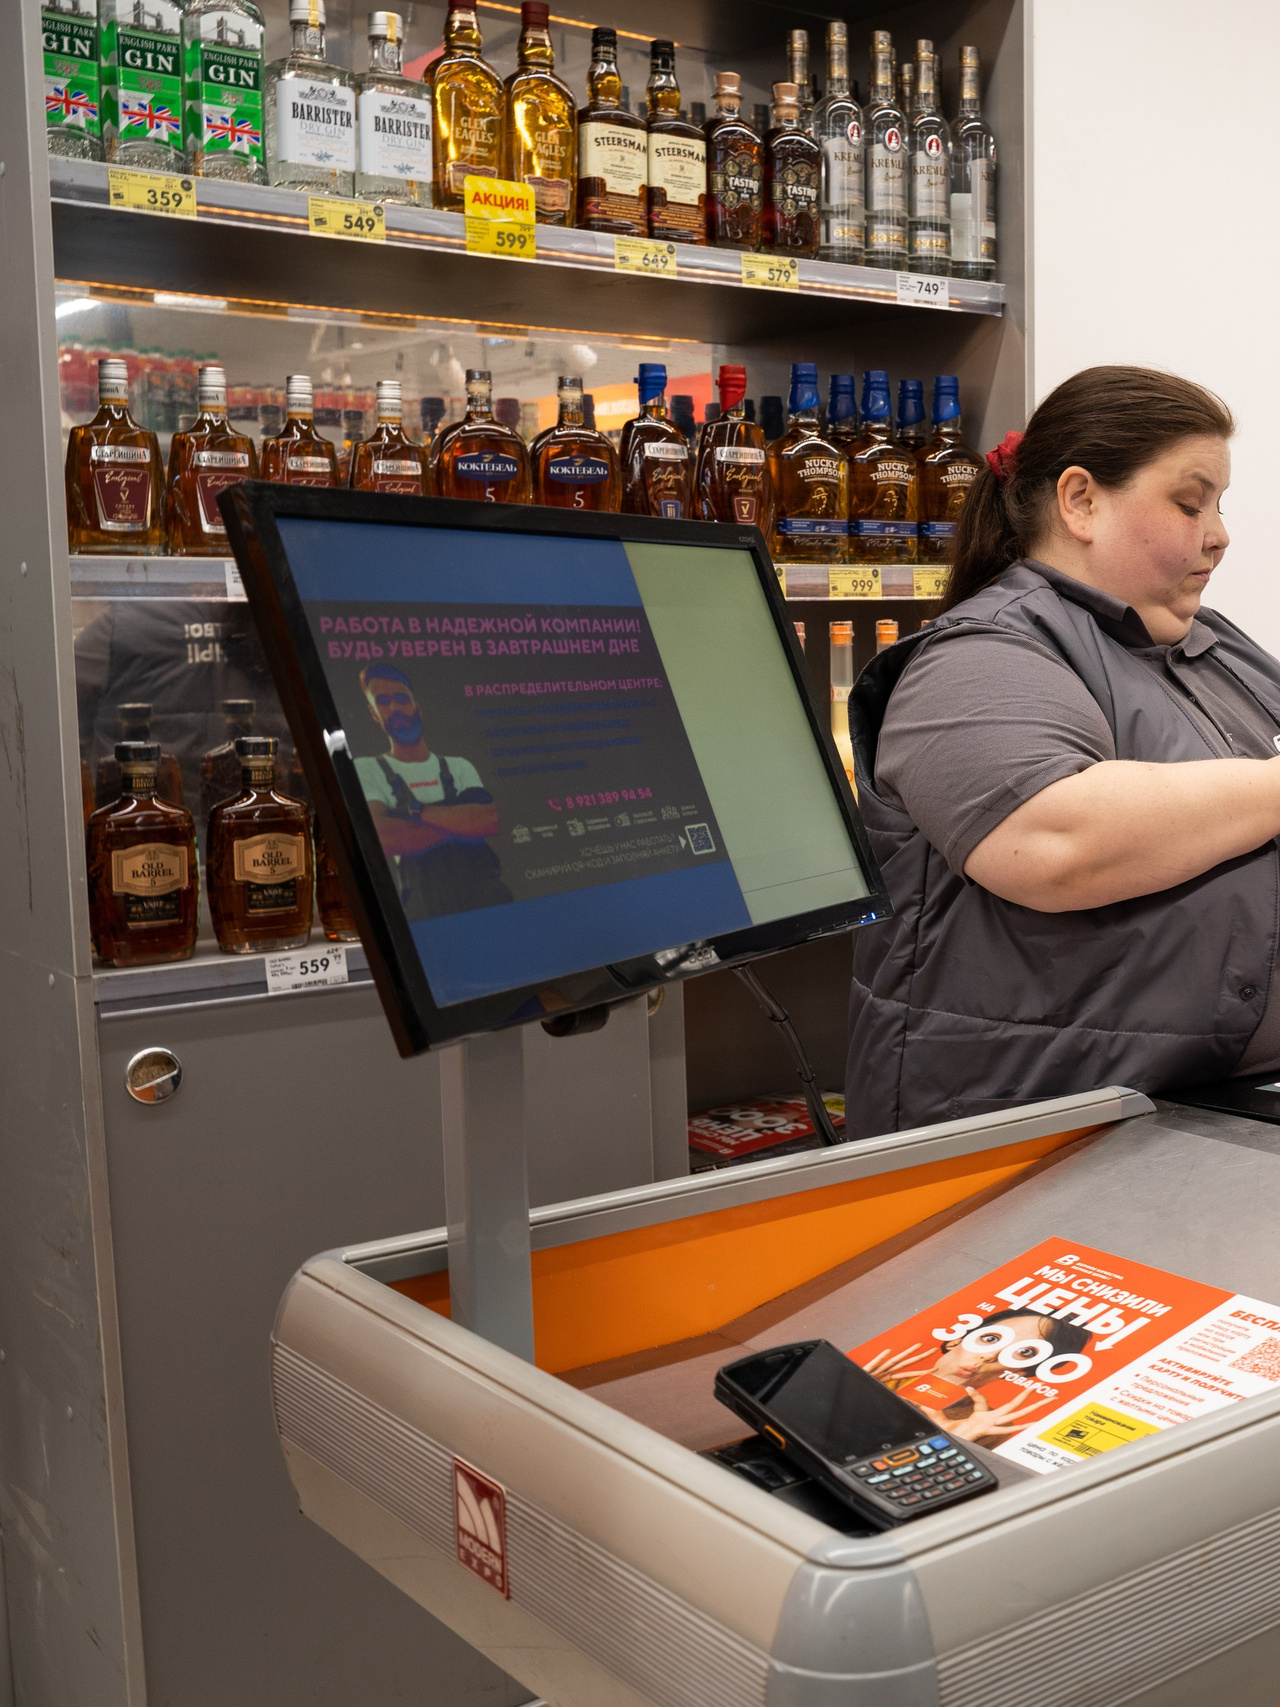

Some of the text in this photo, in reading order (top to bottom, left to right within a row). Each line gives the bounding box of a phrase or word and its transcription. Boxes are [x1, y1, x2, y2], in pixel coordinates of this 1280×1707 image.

[42, 32, 91, 58] GIN
[119, 35, 178, 54] ENGLISH PARK
[124, 50, 174, 73] GIN
[204, 50, 259, 69] ENGLISH PARK
[208, 64, 255, 87] GIN
[291, 101, 353, 128] BARRISTER
[460, 116, 487, 130] GLEN
[300, 120, 322, 133] DRY
[325, 125, 346, 136] GIN
[374, 115, 431, 141] BARRISTER
[455, 127, 494, 144] EAGLES
[382, 134, 402, 145] DRY
[405, 139, 426, 149] GIN
[534, 131, 560, 144] GLEN
[594, 135, 647, 155] STEERSMAN
[655, 147, 706, 165] STEERSMAN
[729, 177, 759, 193] CASTRO
[147, 188, 183, 208] 359
[471, 191, 530, 212] АКЦИЯ!
[787, 186, 817, 202] CASTRO
[343, 214, 376, 232] 549
[496, 231, 527, 250] 599
[642, 253, 668, 269] 649
[768, 268, 791, 282] 579
[917, 281, 939, 295] 749
[457, 461, 517, 473] КОКТЕБЕЛЬ
[550, 465, 608, 476] КОКТЕБЕЛЬ
[804, 458, 838, 469] NUCKY
[876, 462, 909, 473] NUCKY
[947, 465, 979, 476] NUCKY
[652, 466, 685, 488] Ecological
[725, 467, 763, 488] Ecological
[797, 467, 845, 479] THOMPSON
[870, 470, 917, 482] THOMPSON
[484, 487, 495, 503] 5
[572, 491, 584, 508] 5
[851, 579, 874, 592] 999
[319, 613, 641, 636] РАБОТА В НАДЕЖНОЙ КОМПАНИИ!
[327, 638, 640, 661] БУДЬ УВЕРЕН В ЗАВТРАШНЕМ ДНЕ
[464, 677, 663, 697] В РАСПРЕДЕЛИТЕЛЬНОМ ЦЕНТРЕ:
[565, 786, 653, 809] 8 921 389 94 54
[580, 843, 614, 858] ХОЧЕШЬ
[620, 838, 637, 851] НАС
[636, 833, 676, 848] РАБОТАТЬ?
[252, 857, 293, 868] BARREL
[261, 850, 283, 860] OLD
[131, 867, 175, 878] BARREL
[141, 861, 164, 870] OLD
[270, 866, 276, 874] 5
[525, 860, 572, 880] СКАНИРУЙ
[150, 878, 157, 886] 5
[300, 957, 330, 975] 559
[707, 1107, 809, 1135] 3000
[1054, 1254, 1080, 1267] В
[1033, 1265, 1173, 1318] МЫ СНИЗИЛИ
[976, 1301, 996, 1313] НА
[994, 1276, 1152, 1352] ЦЕНЫ
[931, 1313, 1093, 1384] 3000
[1147, 1363, 1182, 1378] КАРТУ
[1158, 1357, 1235, 1387] АКТИВИРУЙТЕ
[998, 1370, 1060, 1398] ТОВАРОВ
[1140, 1374, 1205, 1403] Персональные
[1119, 1389, 1166, 1411] Скидки на
[1130, 1382, 1191, 1407] предложения
[1083, 1415, 1106, 1427] товара
[1088, 1410, 1137, 1432] Наименование
[1020, 1446, 1046, 1461] товары
[1026, 1441, 1046, 1452] цена
